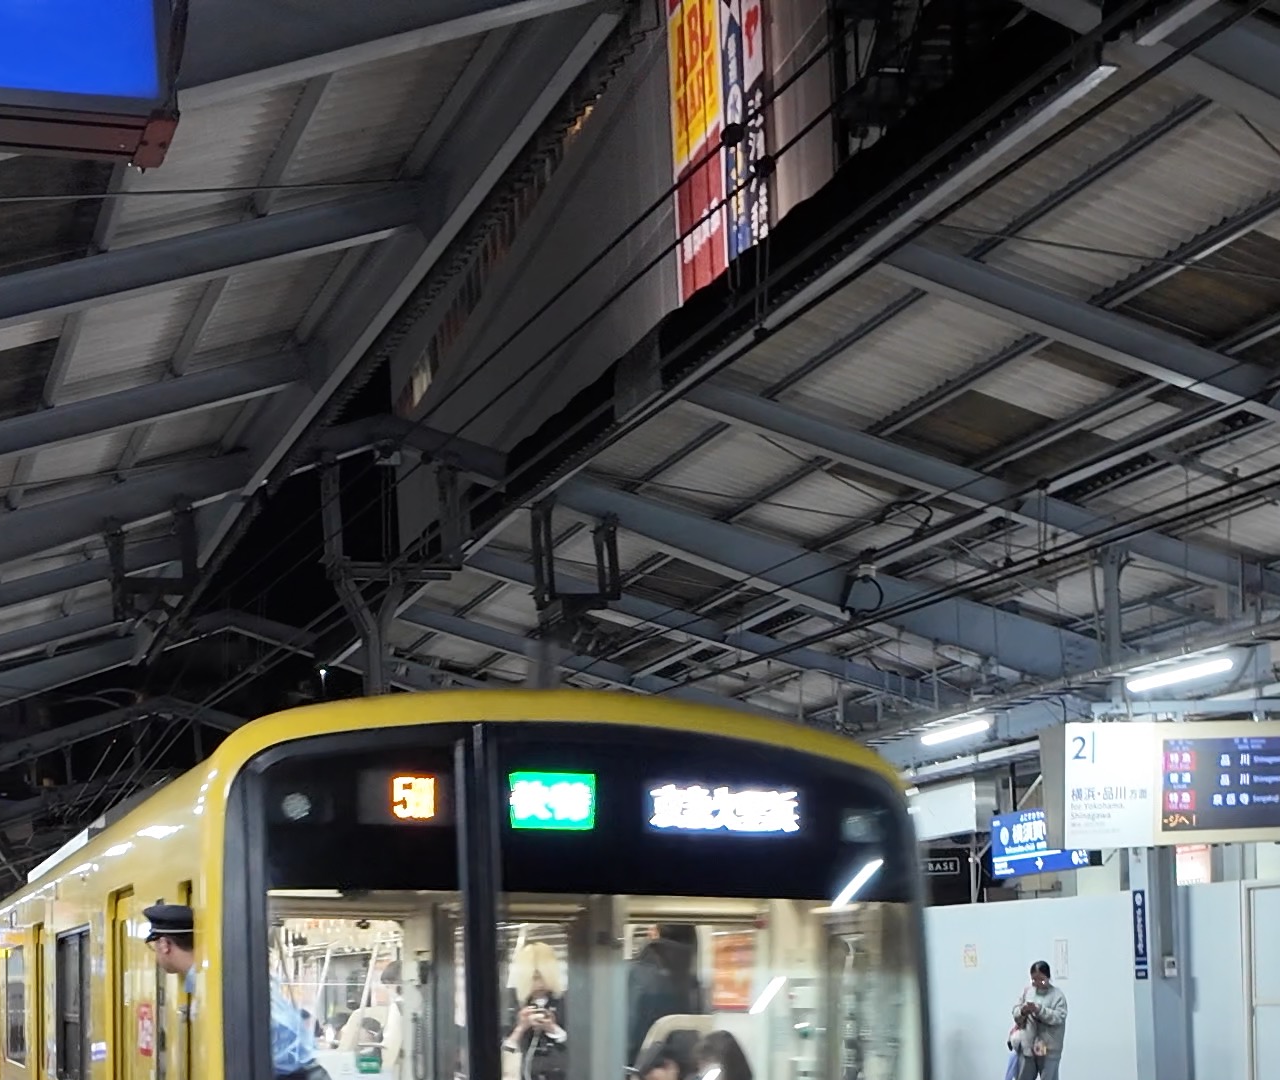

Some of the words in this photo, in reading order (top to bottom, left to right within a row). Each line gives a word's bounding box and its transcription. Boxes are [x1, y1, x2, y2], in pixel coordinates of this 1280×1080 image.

[1071, 736, 1087, 760] 2
[1220, 753, 1250, 767] 品川
[1220, 773, 1250, 787] 品川
